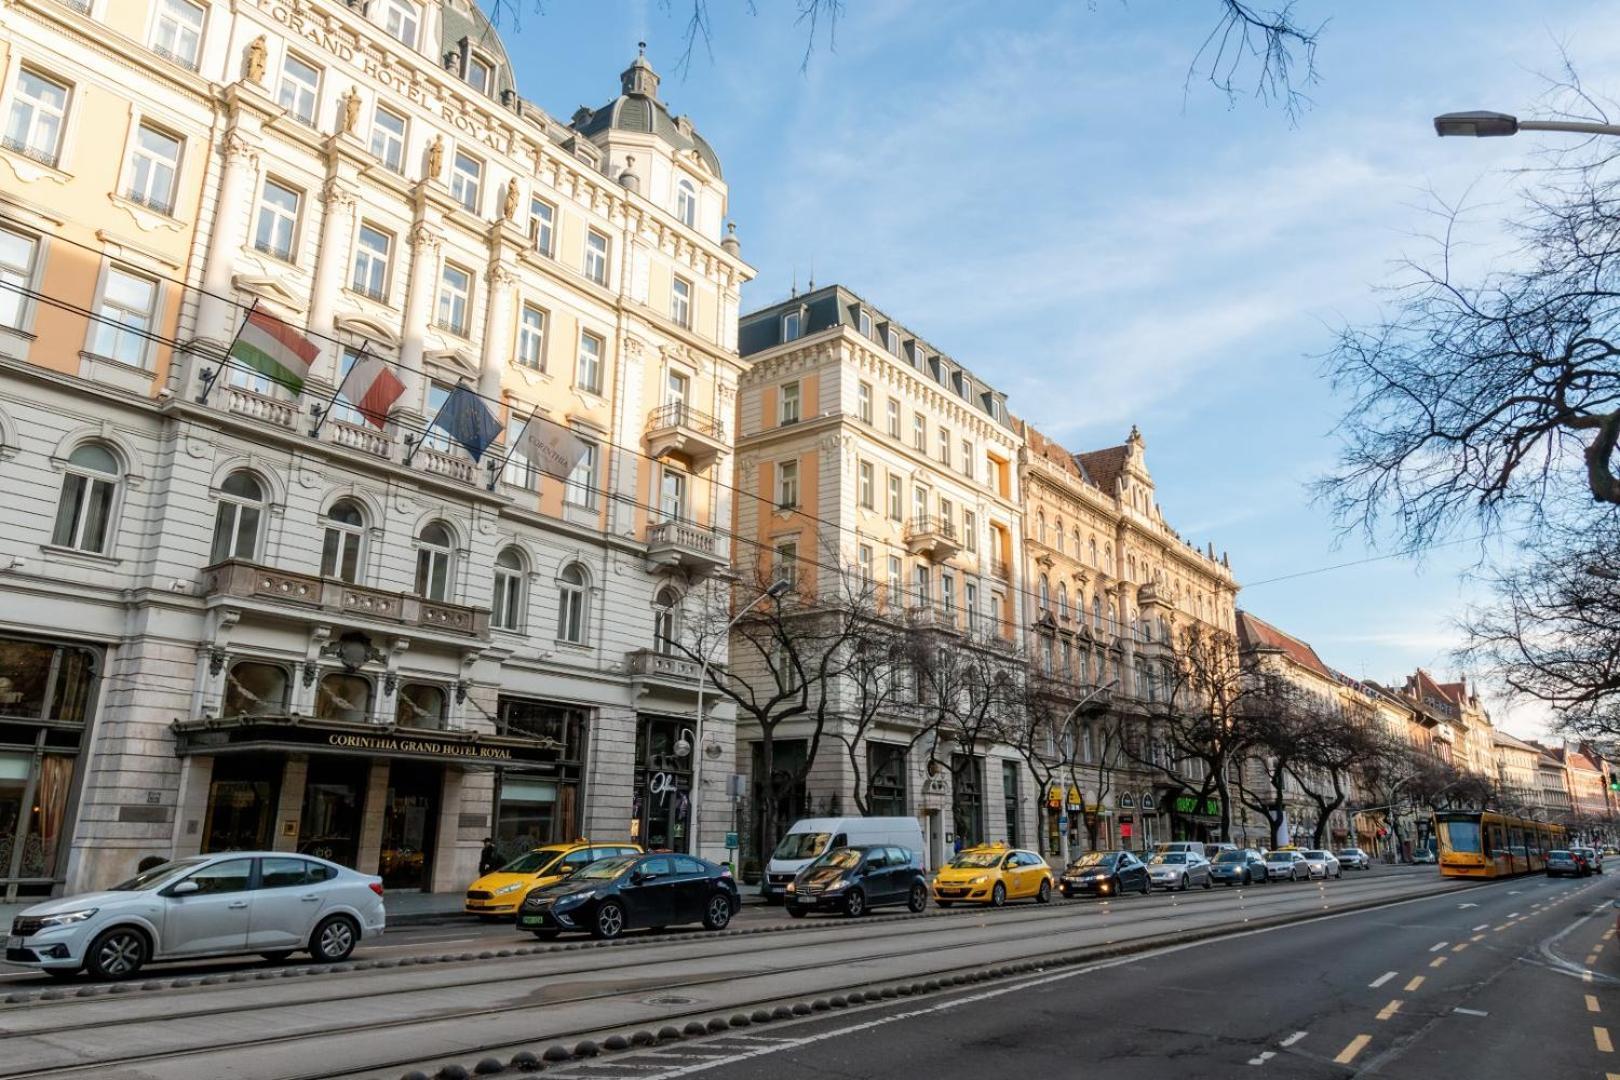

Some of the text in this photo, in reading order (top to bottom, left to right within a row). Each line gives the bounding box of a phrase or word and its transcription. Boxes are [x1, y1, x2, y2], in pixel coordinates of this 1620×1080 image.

[272, 6, 505, 155] GRAND HOTEL ROYAL
[329, 734, 512, 760] CORINTHIA GRAND HOTEL ROYAL
